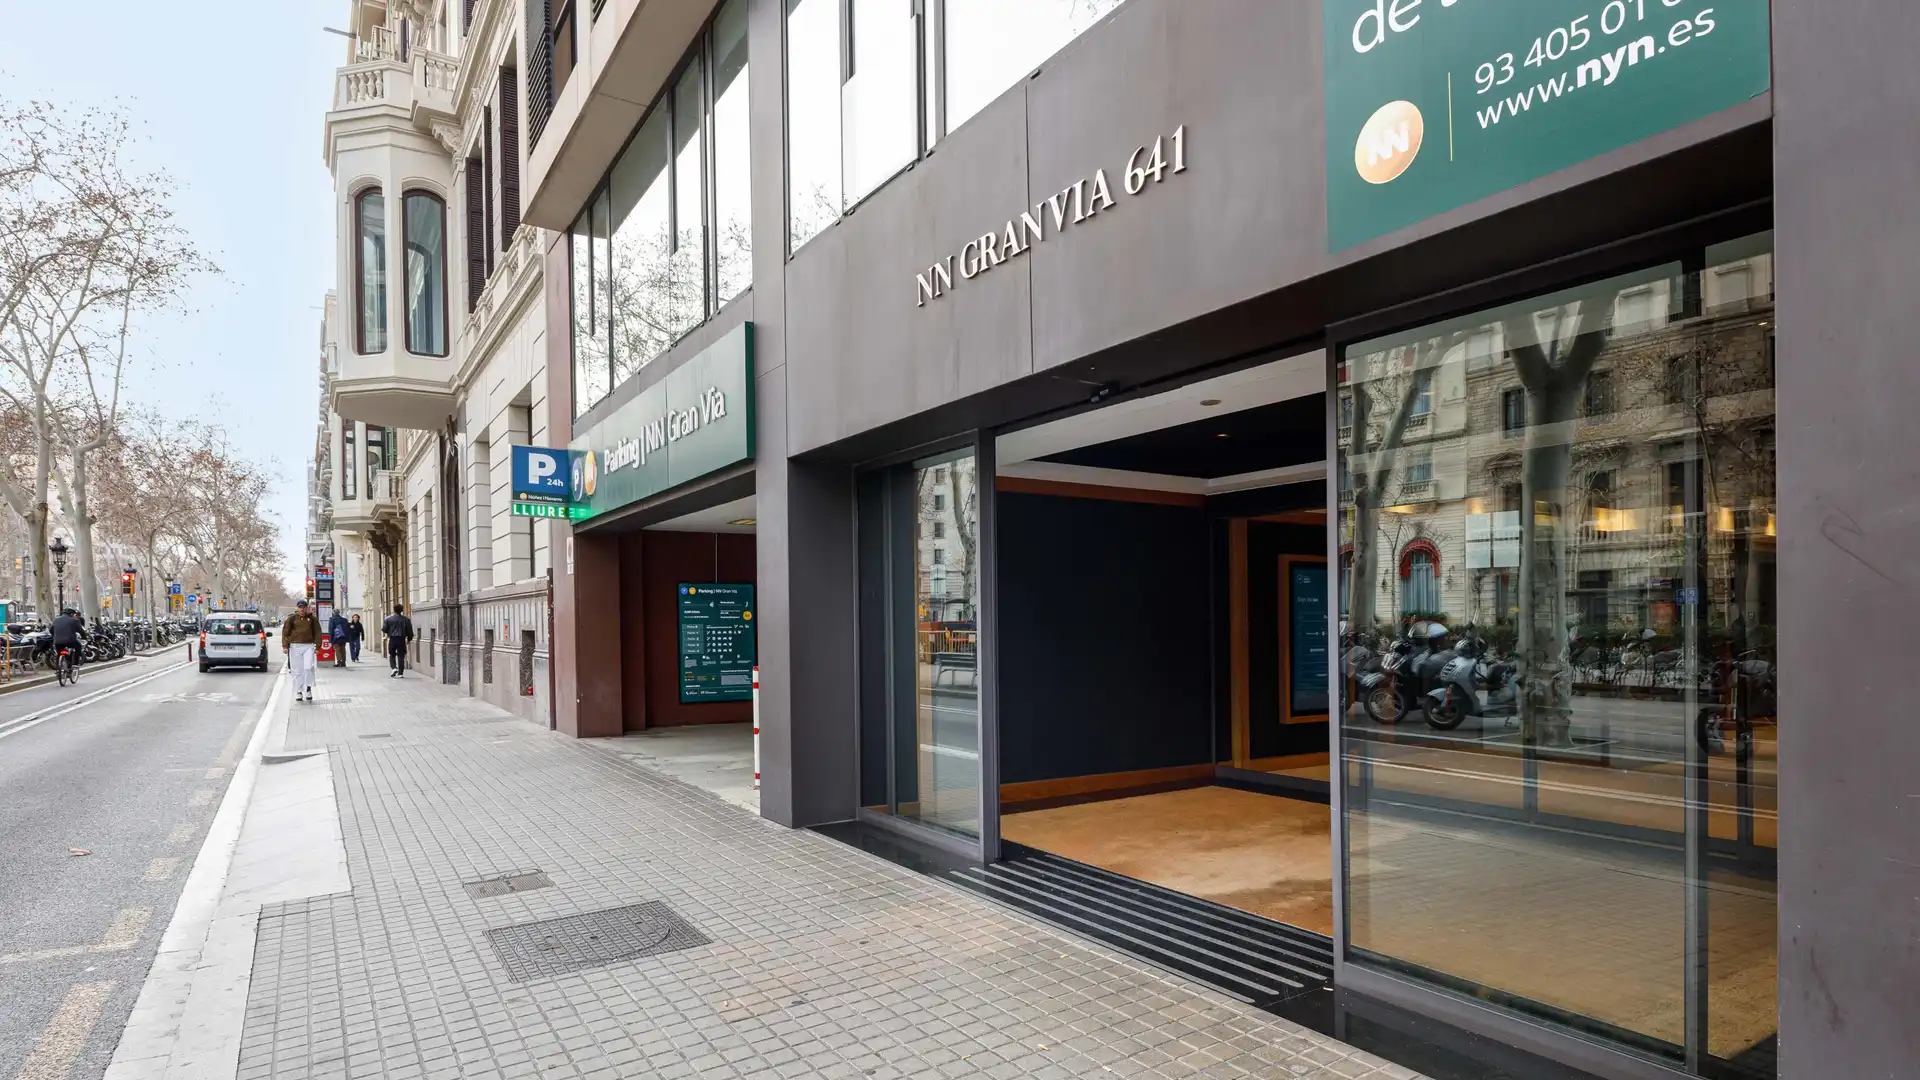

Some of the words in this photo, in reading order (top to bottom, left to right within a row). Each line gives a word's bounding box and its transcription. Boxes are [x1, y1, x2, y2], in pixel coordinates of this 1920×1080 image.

[1352, 0, 1421, 53] de
[1474, 53, 1514, 94] 93
[1523, 15, 1590, 69] 405
[1476, 8, 1716, 129] www.nyn.es
[916, 256, 953, 307] NN
[959, 202, 1045, 279] GRAN
[1048, 168, 1116, 232] VIA
[1124, 124, 1187, 195] 641
[604, 438, 640, 475] Parking
[645, 417, 665, 454] NN
[667, 406, 699, 442] Gran
[700, 386, 726, 424] Via
[528, 452, 556, 484] P
[546, 478, 564, 487] 24h
[574, 469, 580, 491] P
[513, 504, 565, 518] LLIURE
